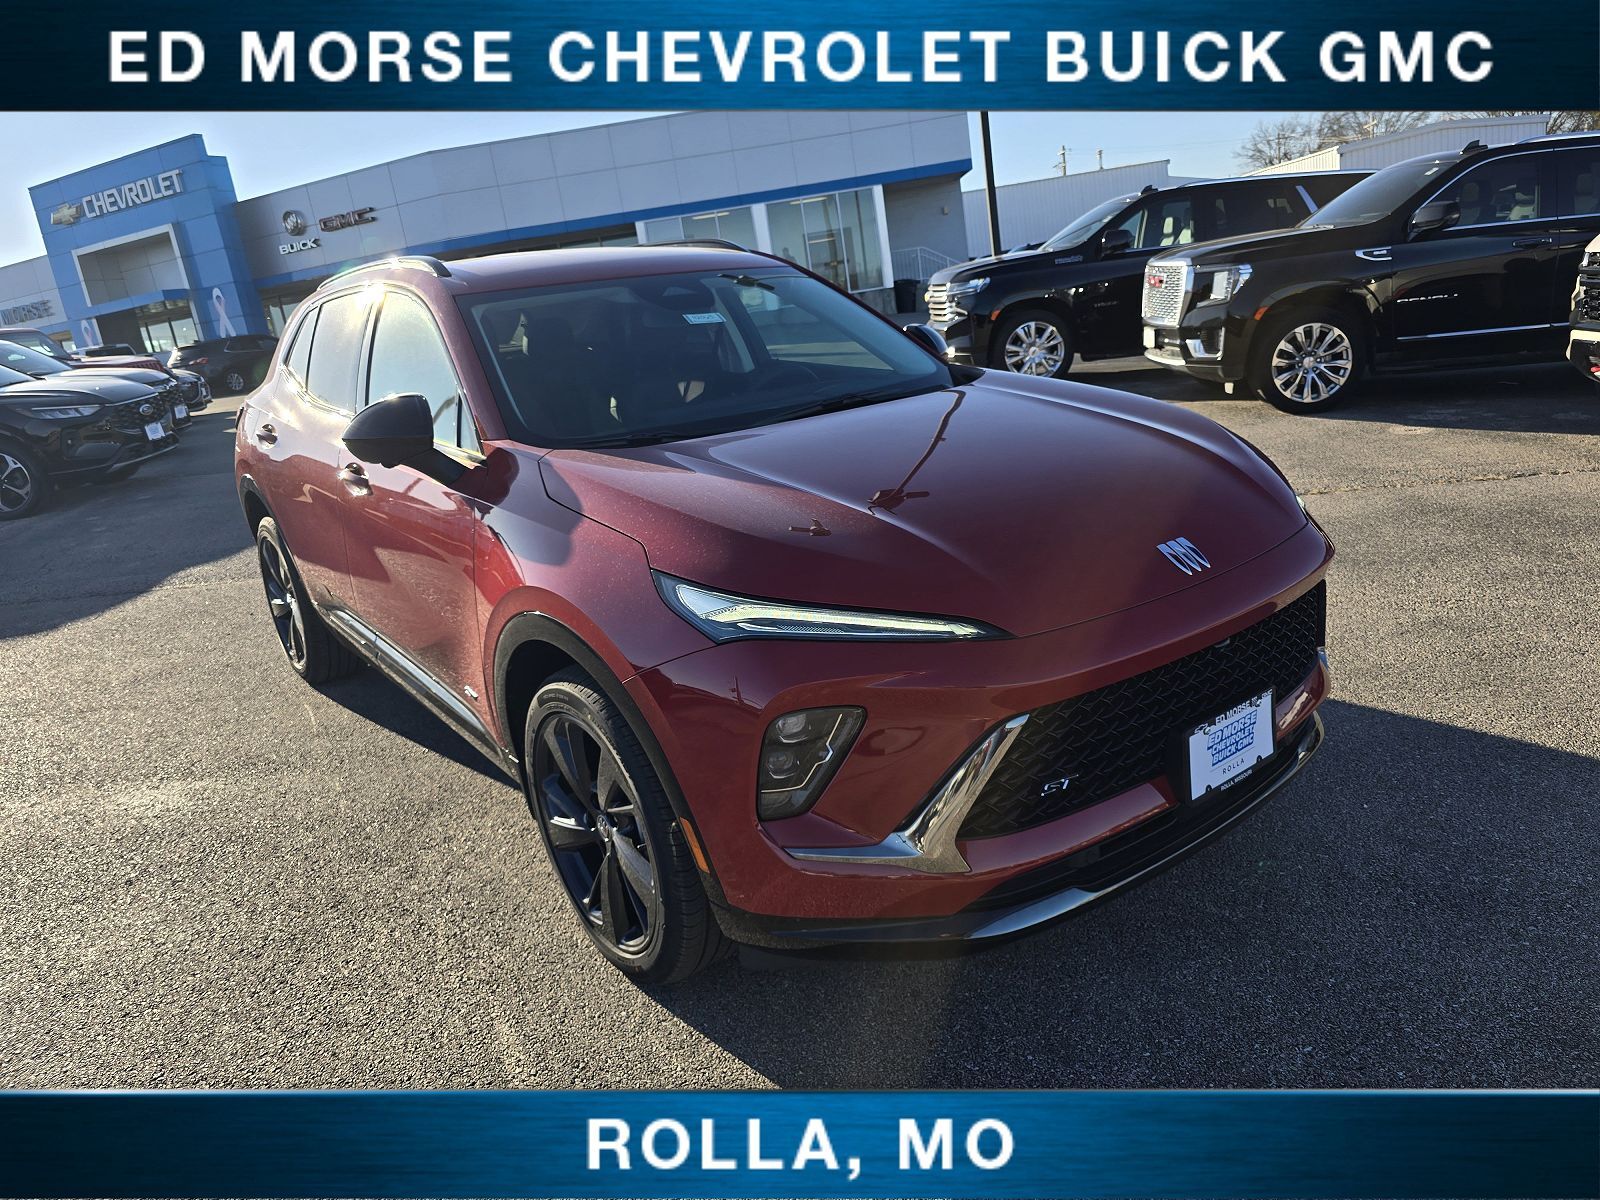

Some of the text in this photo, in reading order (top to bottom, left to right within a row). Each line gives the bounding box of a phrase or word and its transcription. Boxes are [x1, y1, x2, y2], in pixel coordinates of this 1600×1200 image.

[81, 169, 182, 218] CHEVROLET
[319, 207, 375, 233] GMC
[279, 237, 319, 255] BUICK
[1207, 709, 1258, 750] ED MORSE
[1211, 724, 1255, 755] CHEVROLET
[1222, 758, 1246, 775] ROLLA
